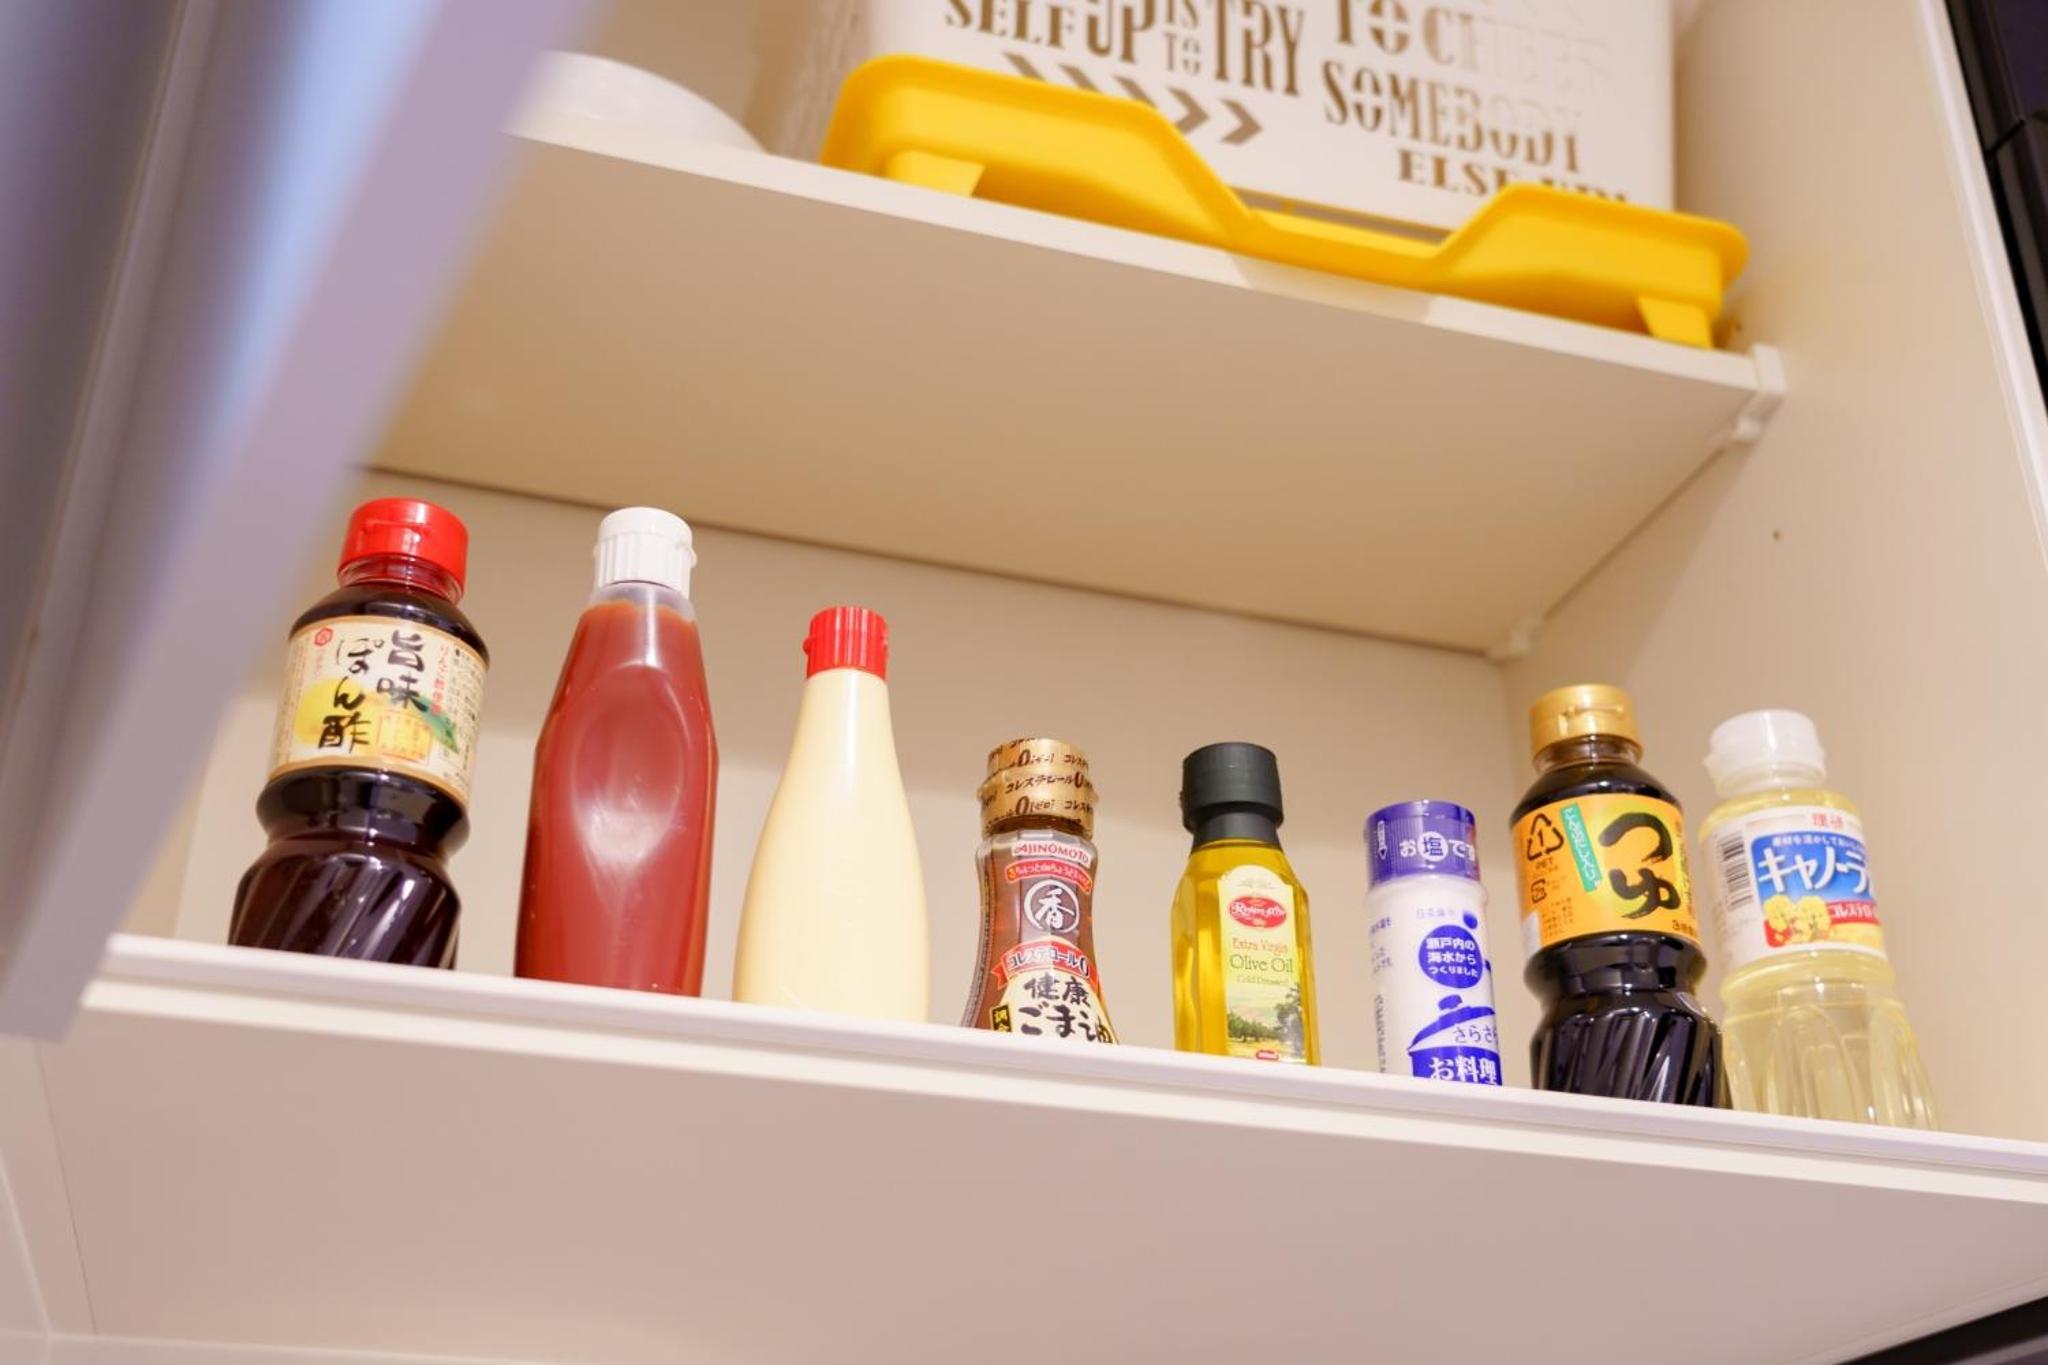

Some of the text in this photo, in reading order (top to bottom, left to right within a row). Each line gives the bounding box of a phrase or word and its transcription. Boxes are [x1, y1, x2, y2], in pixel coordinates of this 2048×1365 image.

[1331, 0, 1412, 56] TO
[1213, 0, 1305, 98] TRY
[376, 628, 429, 711] 旨味
[316, 636, 386, 755] ぽん酢
[1014, 842, 1089, 864] AJINOMOTO
[1598, 811, 1682, 920] つゆ
[1034, 887, 1076, 929] 香
[1229, 953, 1295, 973] Olive Oil
[1425, 937, 1477, 951] 瀬戸内の
[1427, 951, 1477, 965] 海水から
[1023, 971, 1091, 1008] 健康
[1428, 965, 1479, 978] つくりました
